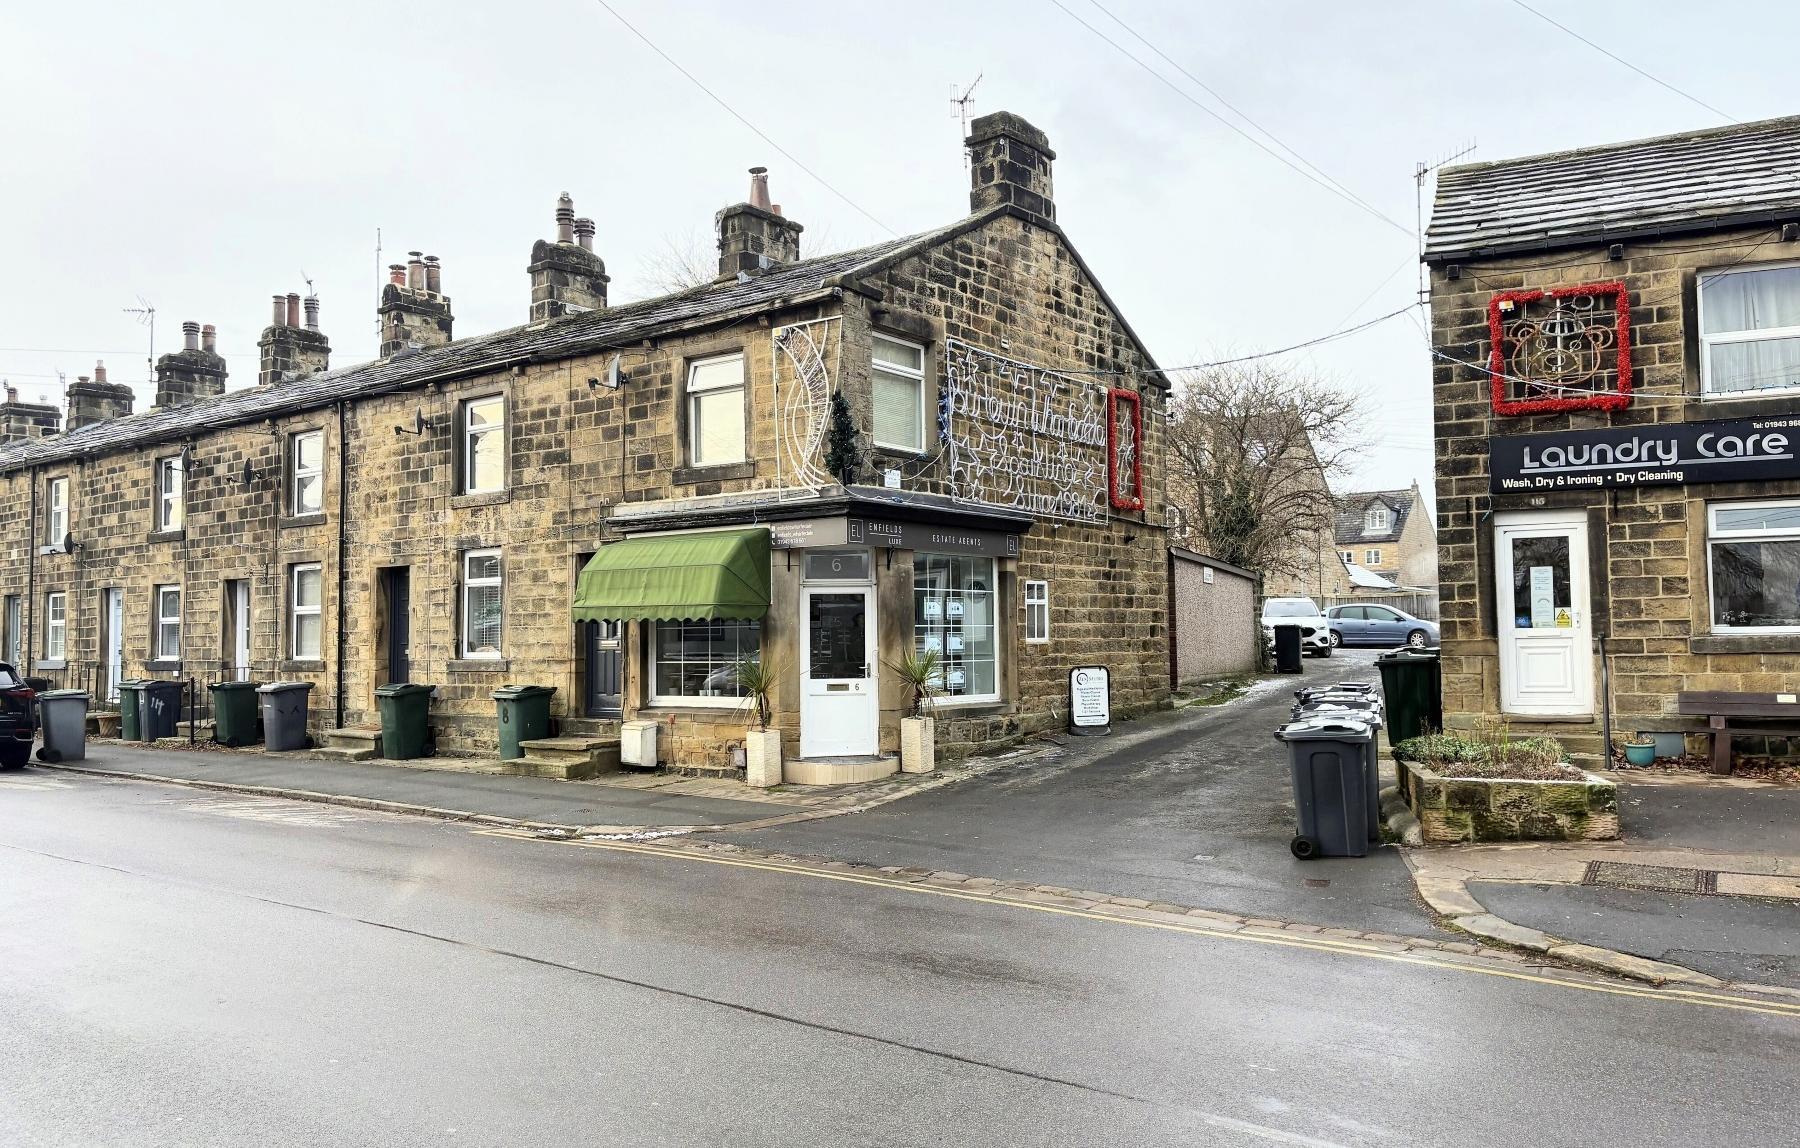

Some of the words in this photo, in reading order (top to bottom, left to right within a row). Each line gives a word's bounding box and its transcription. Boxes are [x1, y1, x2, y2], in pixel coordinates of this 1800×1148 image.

[1764, 420, 1787, 429] 01943
[1523, 436, 1678, 468] Laundry
[1696, 432, 1789, 458] Care
[1502, 478, 1533, 488] Wash,
[1535, 477, 1554, 488] Dry
[1556, 475, 1565, 485] &
[1567, 474, 1603, 486] Ironing
[1616, 472, 1636, 483] Dry
[1637, 469, 1684, 481] Cleaning
[851, 524, 861, 538] EL
[869, 522, 902, 534] ENFIELDS
[888, 537, 902, 545] LUXE
[932, 534, 956, 544] ESTATE
[958, 536, 981, 546] AGENTS
[1009, 539, 1017, 552] EL
[831, 558, 842, 572] 6
[854, 683, 860, 691] 6
[502, 707, 509, 724] 8
